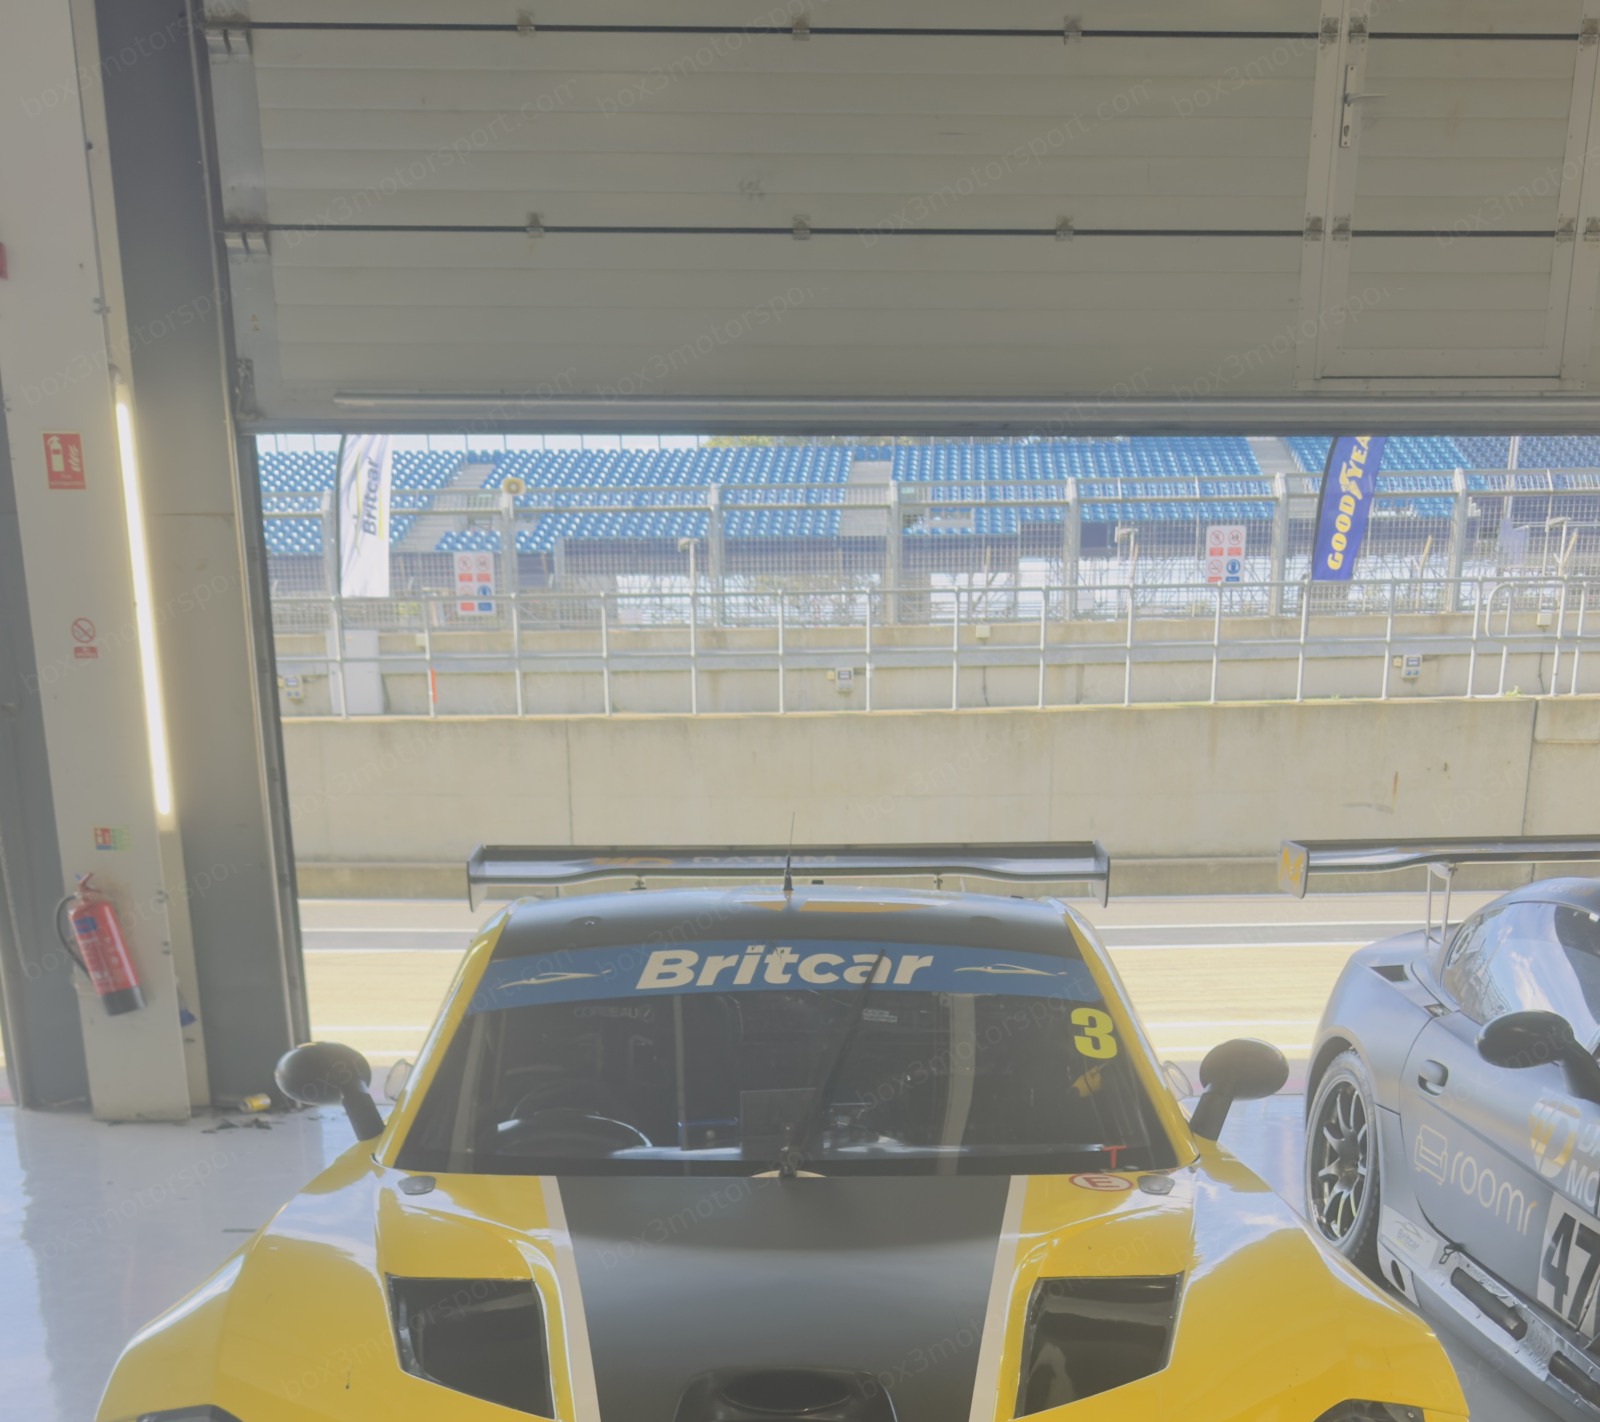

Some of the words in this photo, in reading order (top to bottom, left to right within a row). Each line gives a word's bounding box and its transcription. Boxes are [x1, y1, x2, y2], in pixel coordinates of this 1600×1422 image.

[362, 455, 380, 537] Britcar
[636, 944, 934, 989] Britcar
[1071, 1007, 1119, 1060] 3
[1082, 1176, 1121, 1188] E
[1450, 1150, 1537, 1236] roomr
